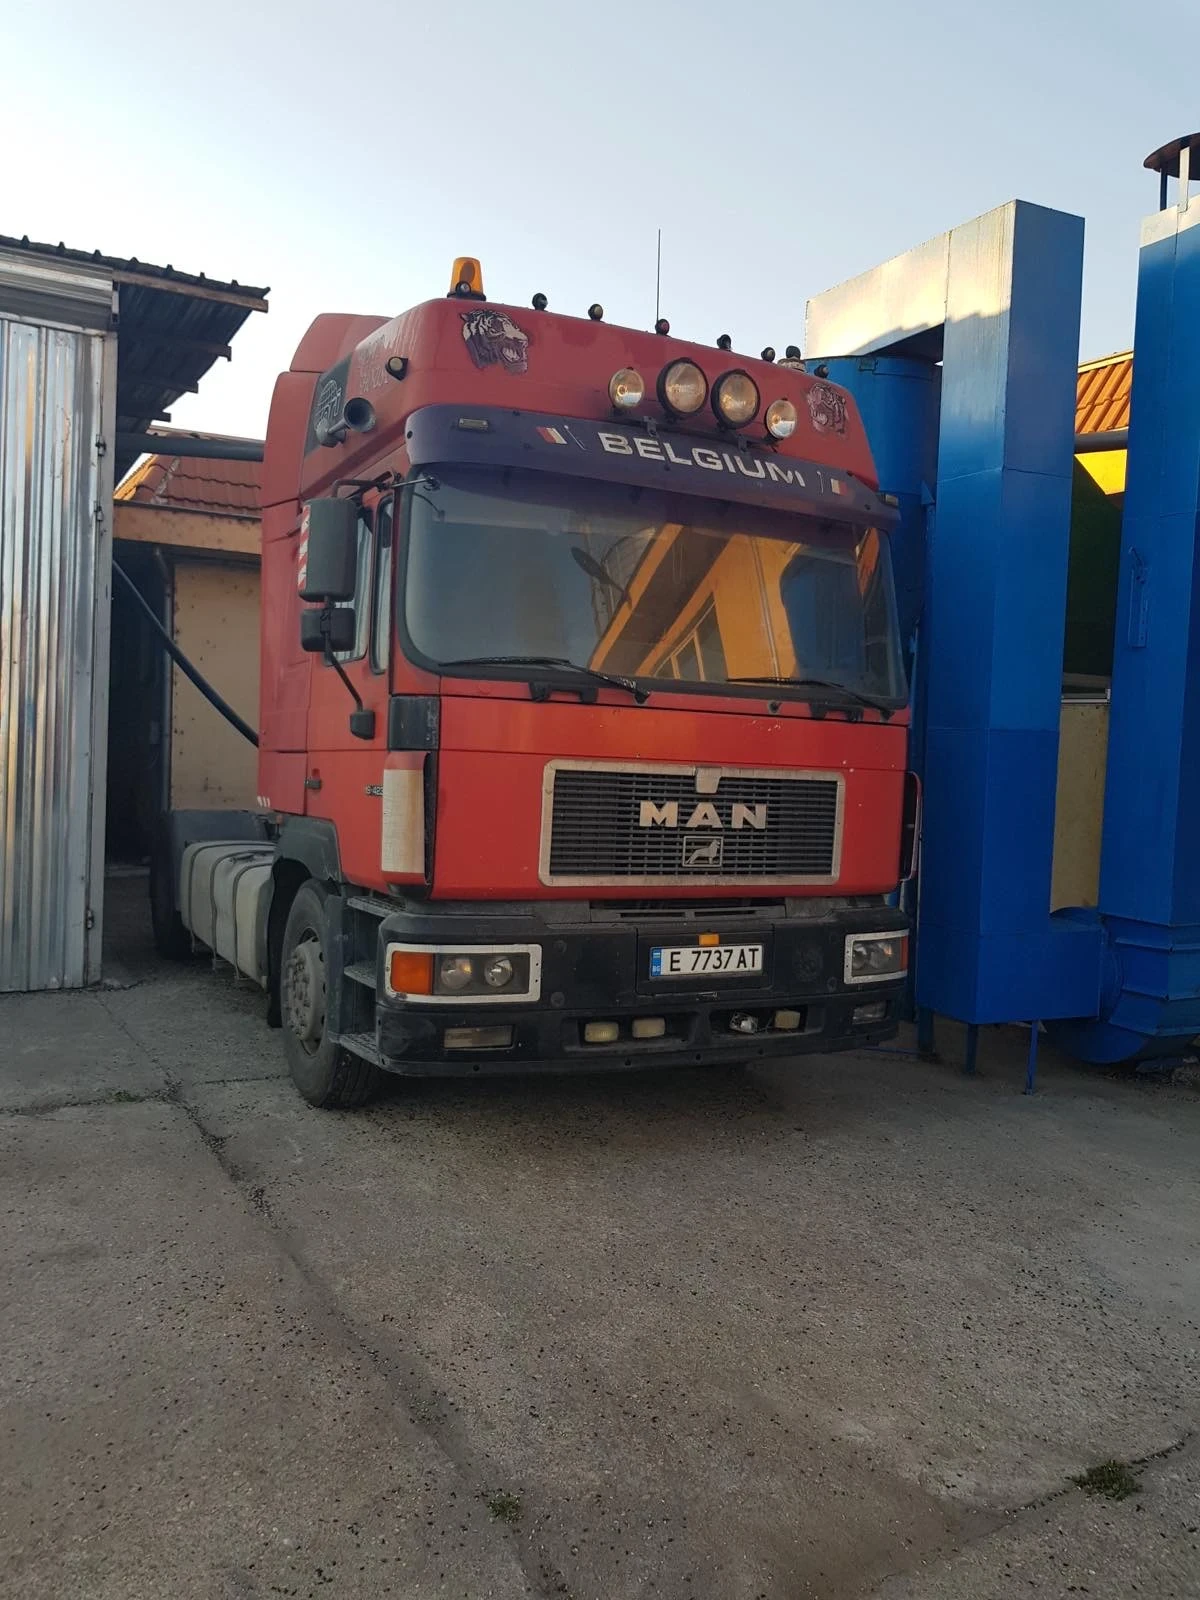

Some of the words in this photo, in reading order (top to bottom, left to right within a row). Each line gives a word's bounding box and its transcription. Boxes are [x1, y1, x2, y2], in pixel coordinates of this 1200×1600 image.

[597, 432, 806, 487] BELGIUM
[639, 801, 767, 829] MAN
[669, 951, 681, 972] E
[691, 949, 733, 971] 7737
[737, 948, 759, 969] AT
